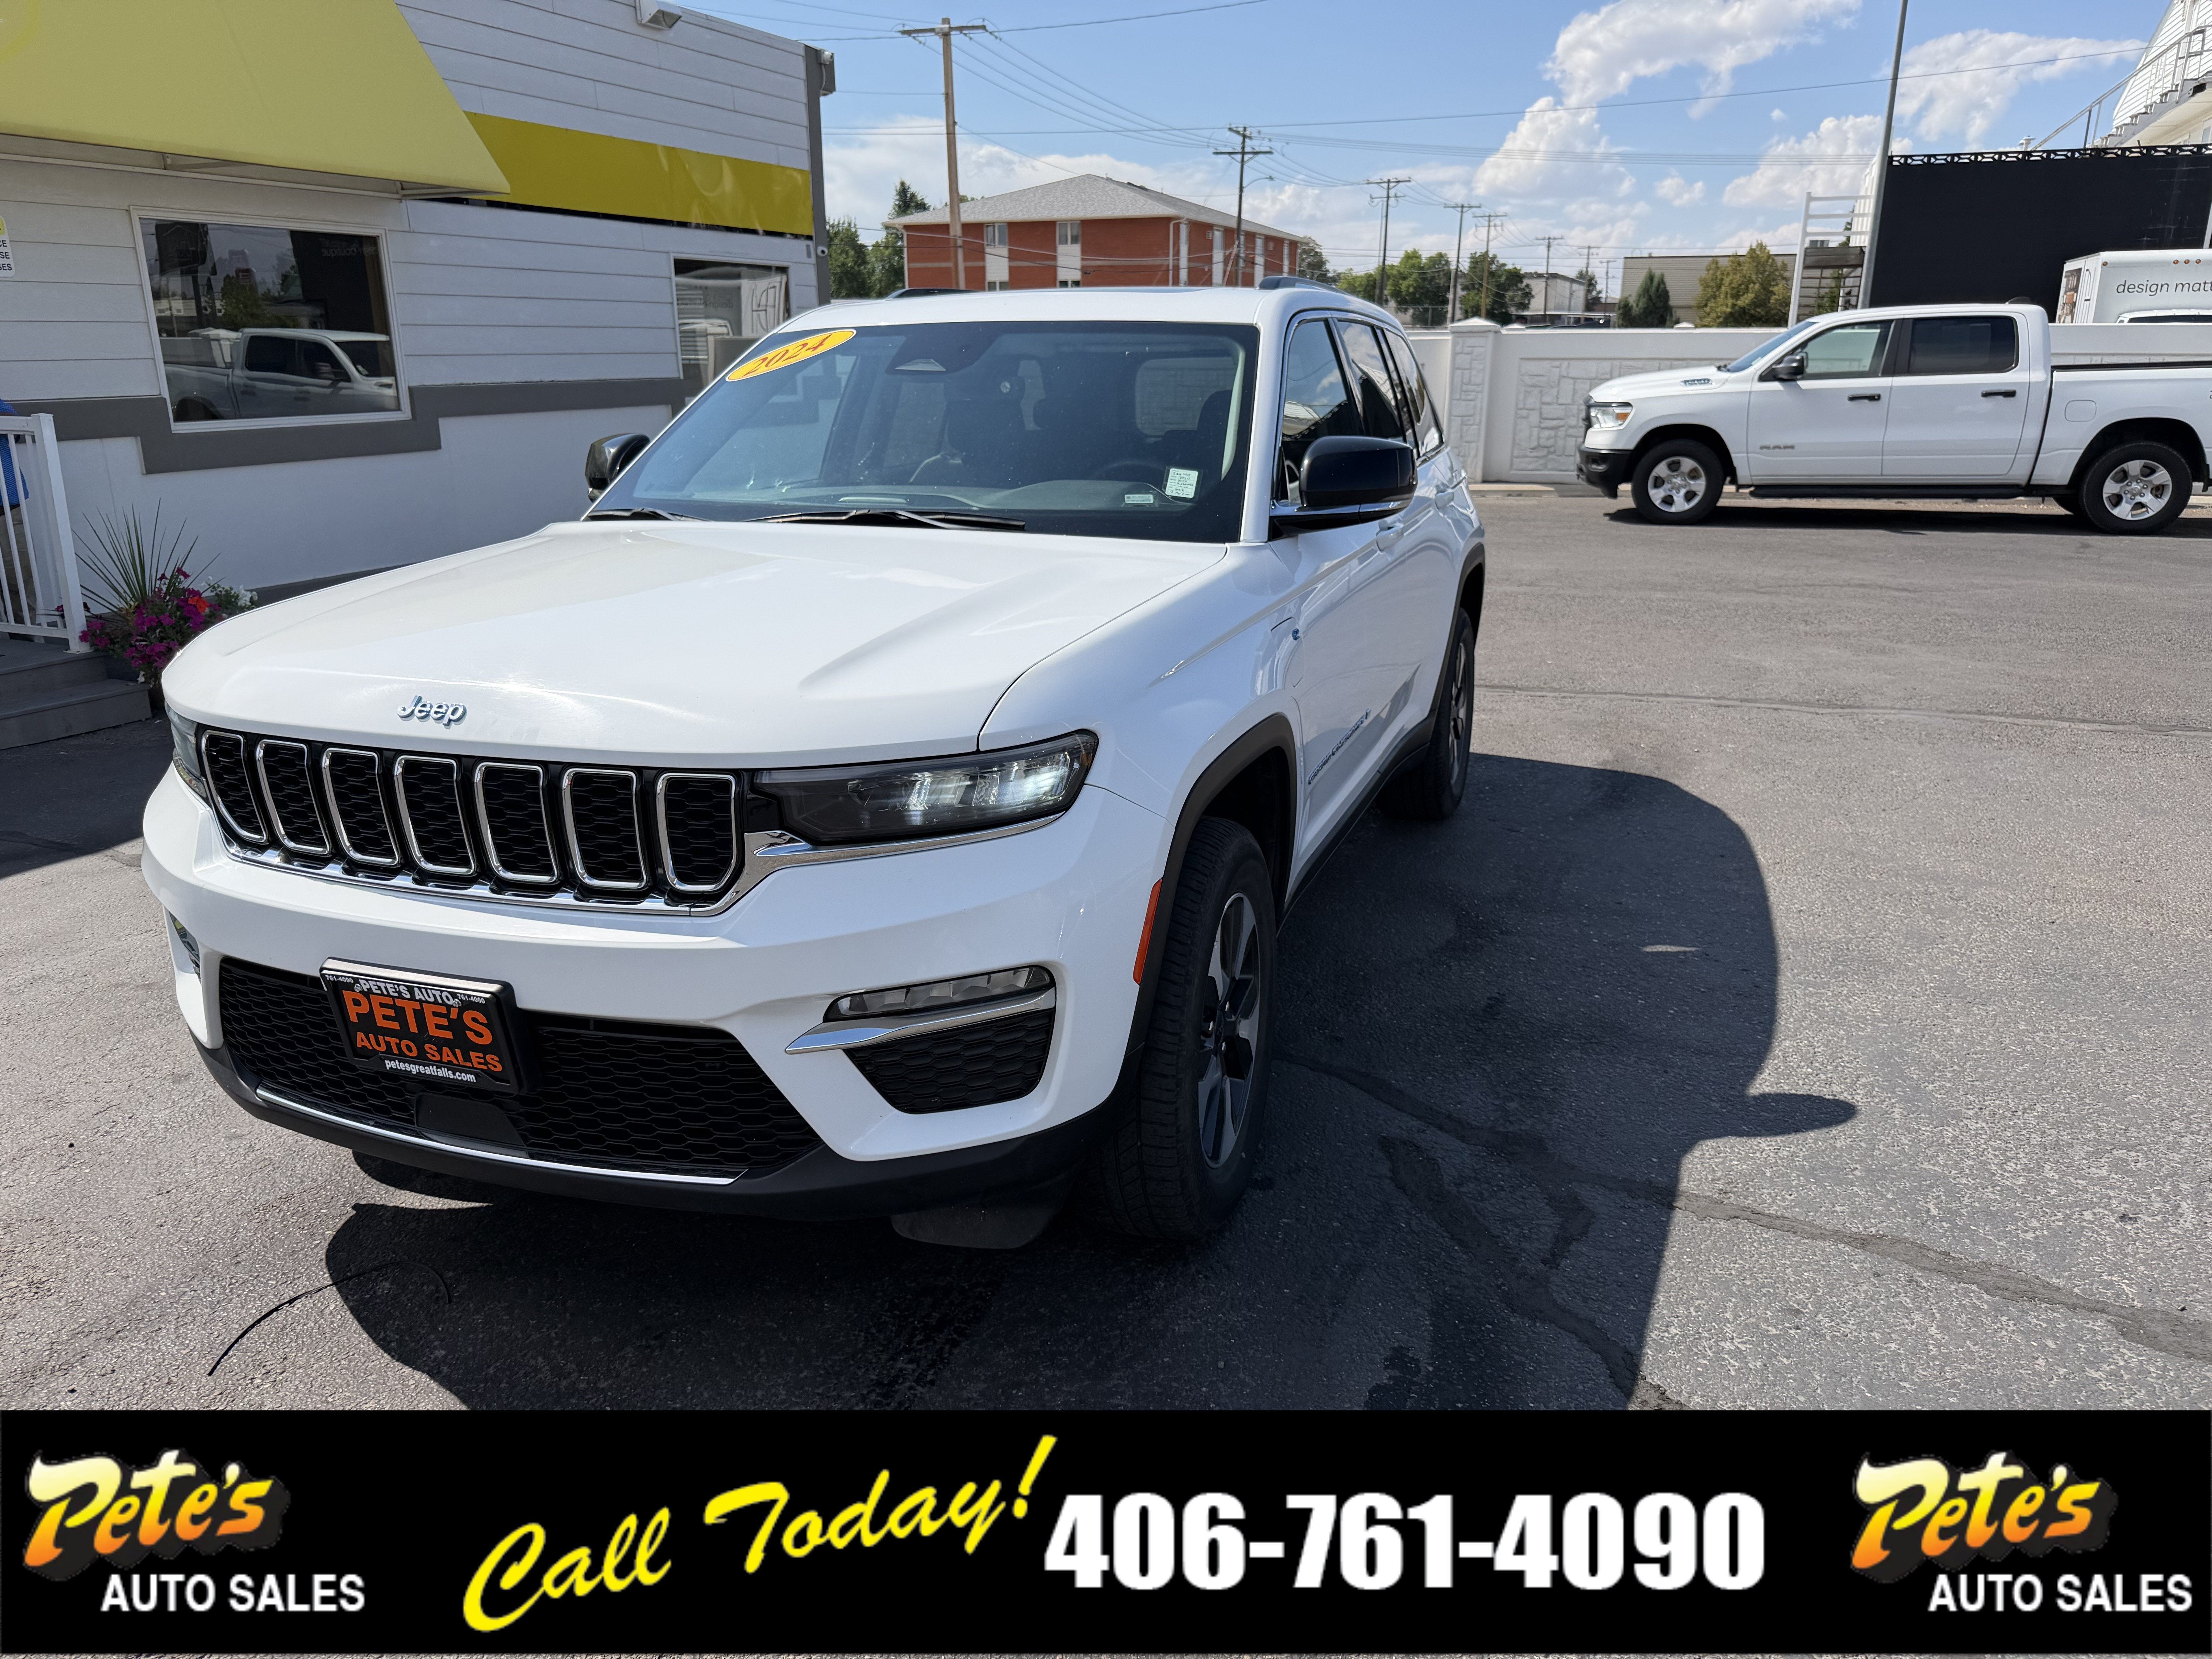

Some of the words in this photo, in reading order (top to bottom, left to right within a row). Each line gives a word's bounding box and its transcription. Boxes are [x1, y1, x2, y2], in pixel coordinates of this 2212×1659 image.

[2116, 280, 2169, 296] design
[742, 334, 832, 377] 2024
[397, 695, 467, 728] Jeep
[359, 979, 410, 998] PETE'S
[414, 987, 453, 1005] AUTO
[342, 990, 493, 1045] PETE'S
[357, 1032, 418, 1057] AUTO
[424, 1044, 503, 1072] SALES
[385, 1060, 476, 1082] petesgreatfalls.com
